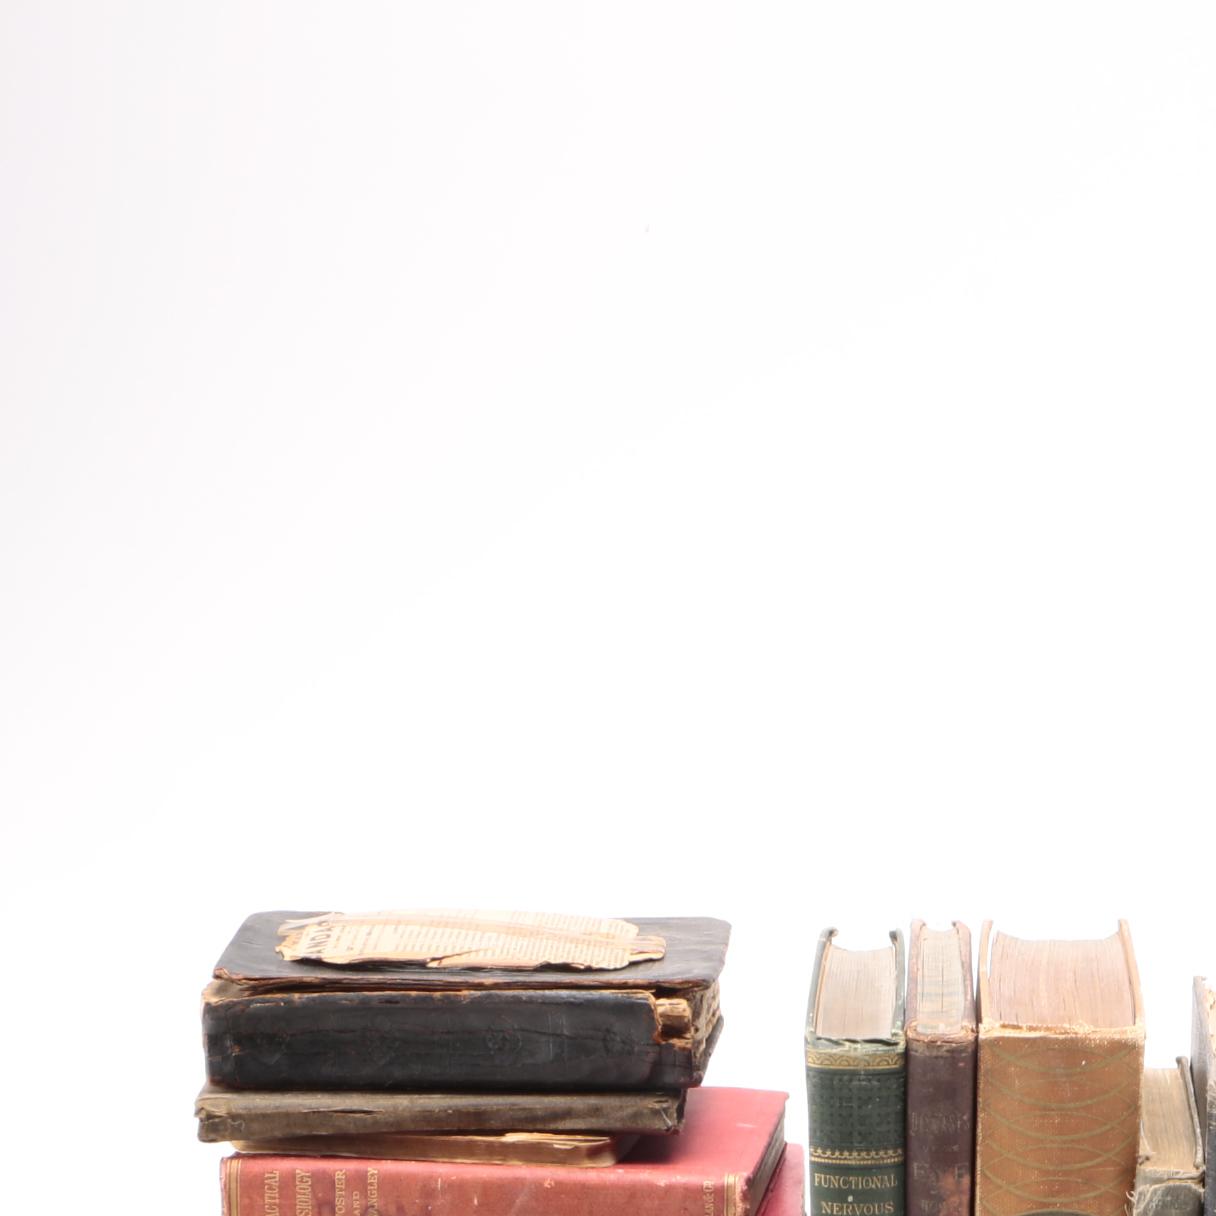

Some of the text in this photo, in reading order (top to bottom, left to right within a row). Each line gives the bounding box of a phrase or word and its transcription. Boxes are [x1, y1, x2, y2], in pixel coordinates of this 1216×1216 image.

[814, 1173, 898, 1190] FUNCTIONAL
[352, 1190, 361, 1216] AND
[821, 1200, 895, 1216] NERVOUS
